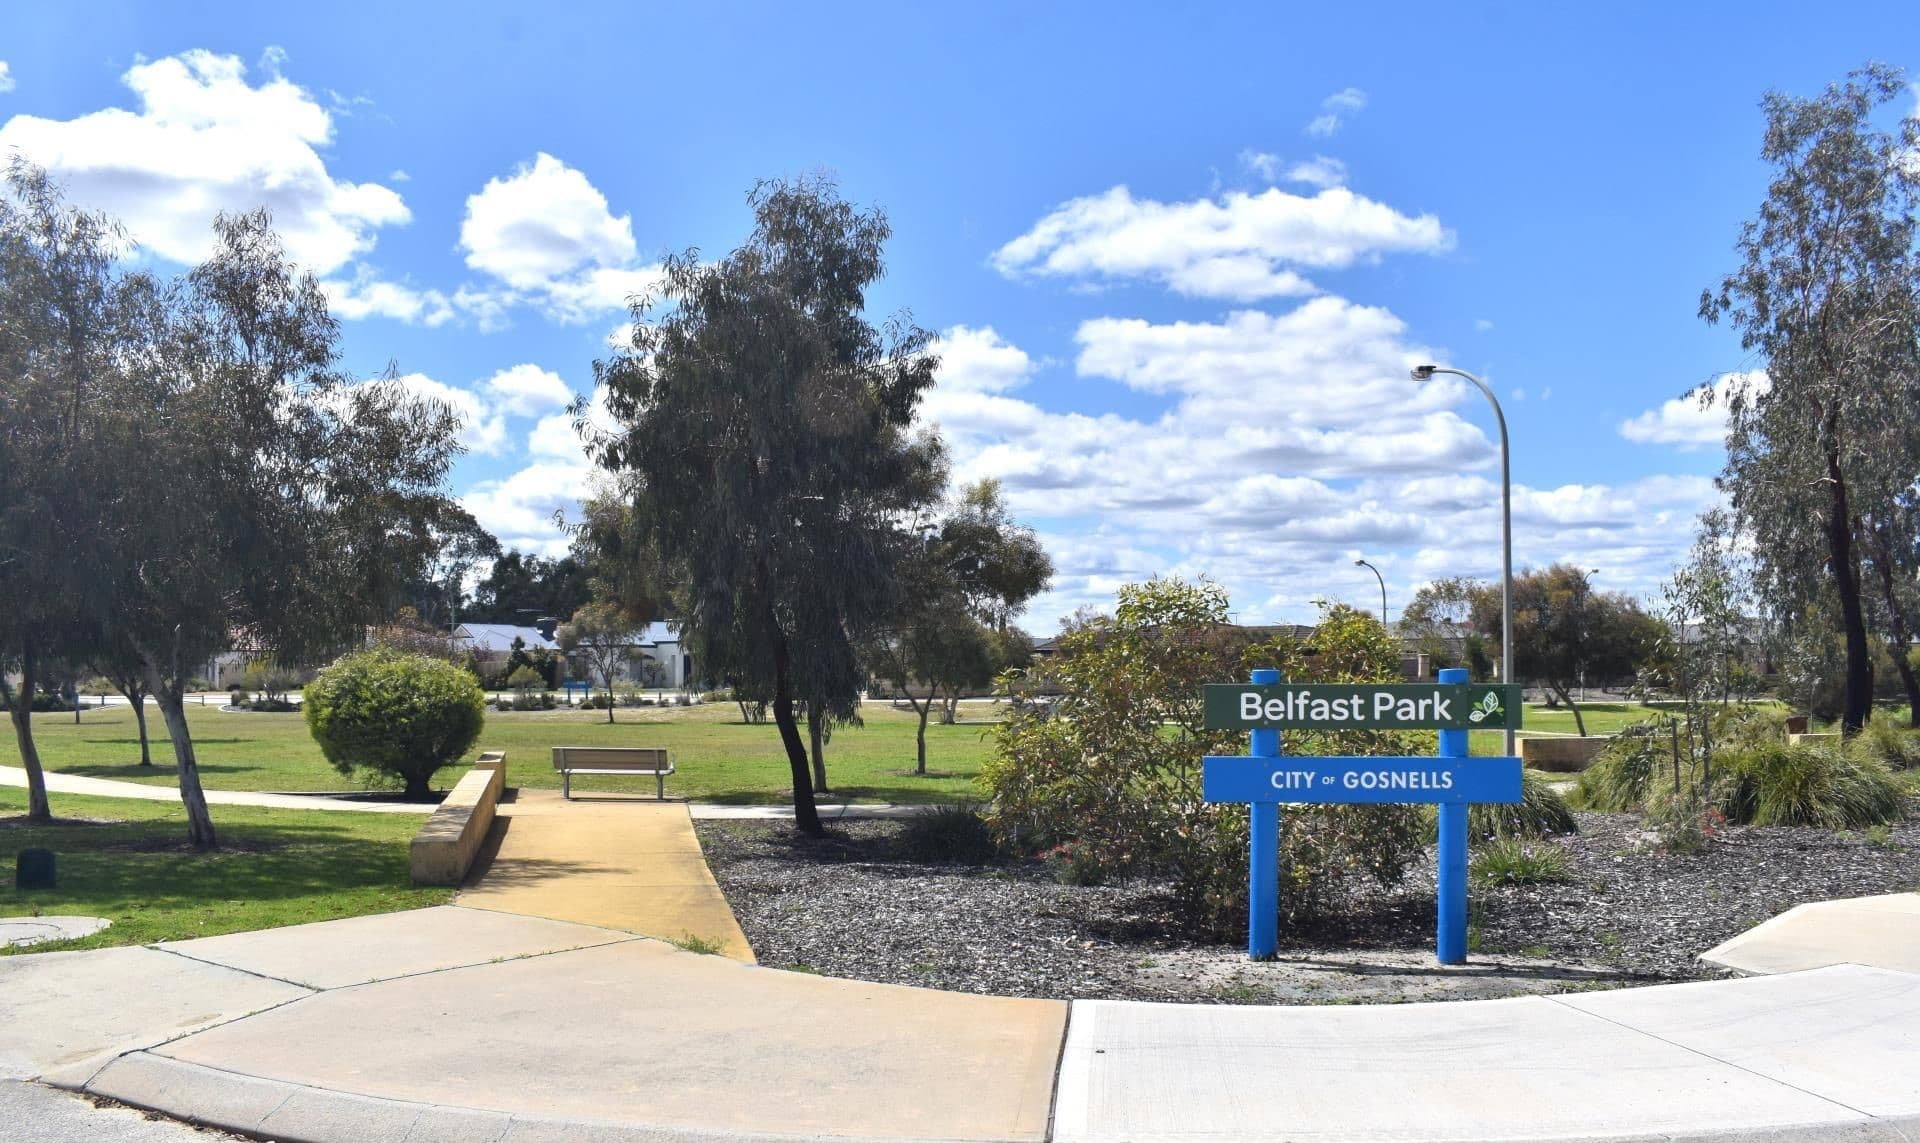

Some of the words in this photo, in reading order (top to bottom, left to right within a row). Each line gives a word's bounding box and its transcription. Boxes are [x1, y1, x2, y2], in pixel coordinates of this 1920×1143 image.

[1240, 691, 1365, 721] Belfast
[1373, 691, 1453, 721] Park
[1271, 771, 1316, 789] CITY
[1321, 776, 1336, 786] OF
[1343, 771, 1453, 789] GOSNELLS
